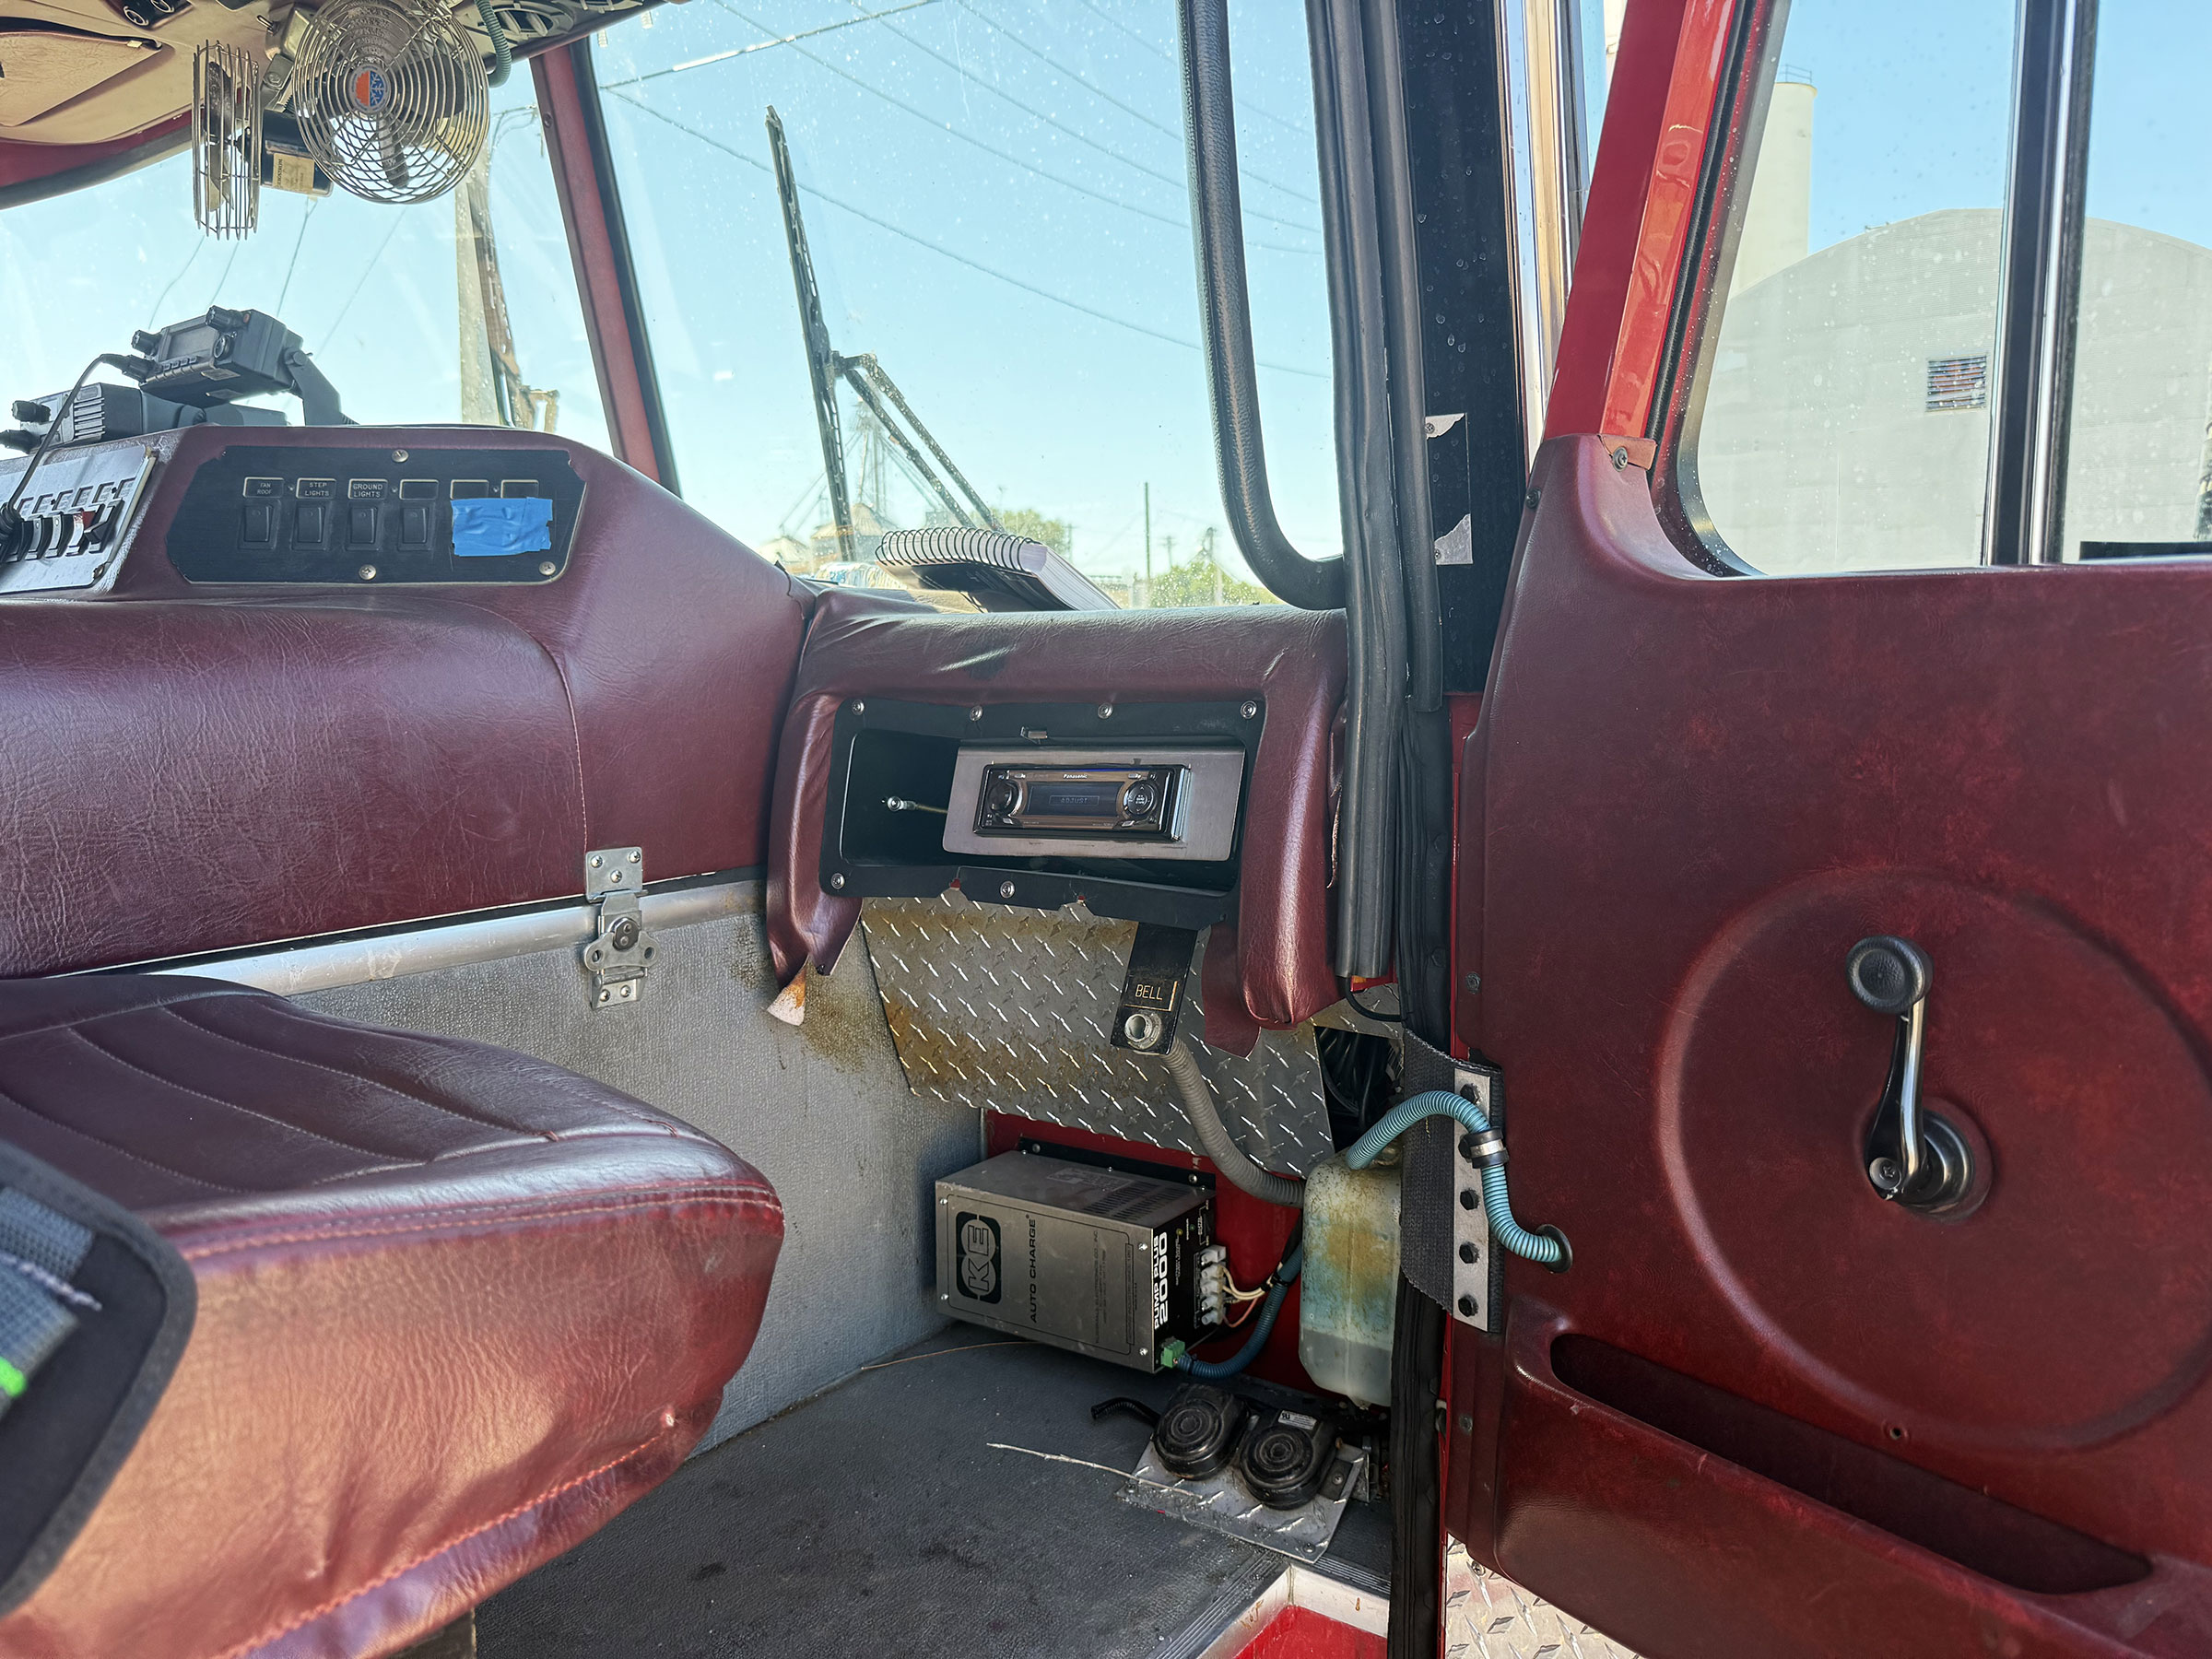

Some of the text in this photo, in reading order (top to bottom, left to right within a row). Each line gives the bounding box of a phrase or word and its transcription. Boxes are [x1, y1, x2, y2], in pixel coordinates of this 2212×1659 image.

[1135, 983, 1163, 1001] BELL
[968, 1224, 990, 1292] KE
[1159, 1231, 1169, 1325] 2000
